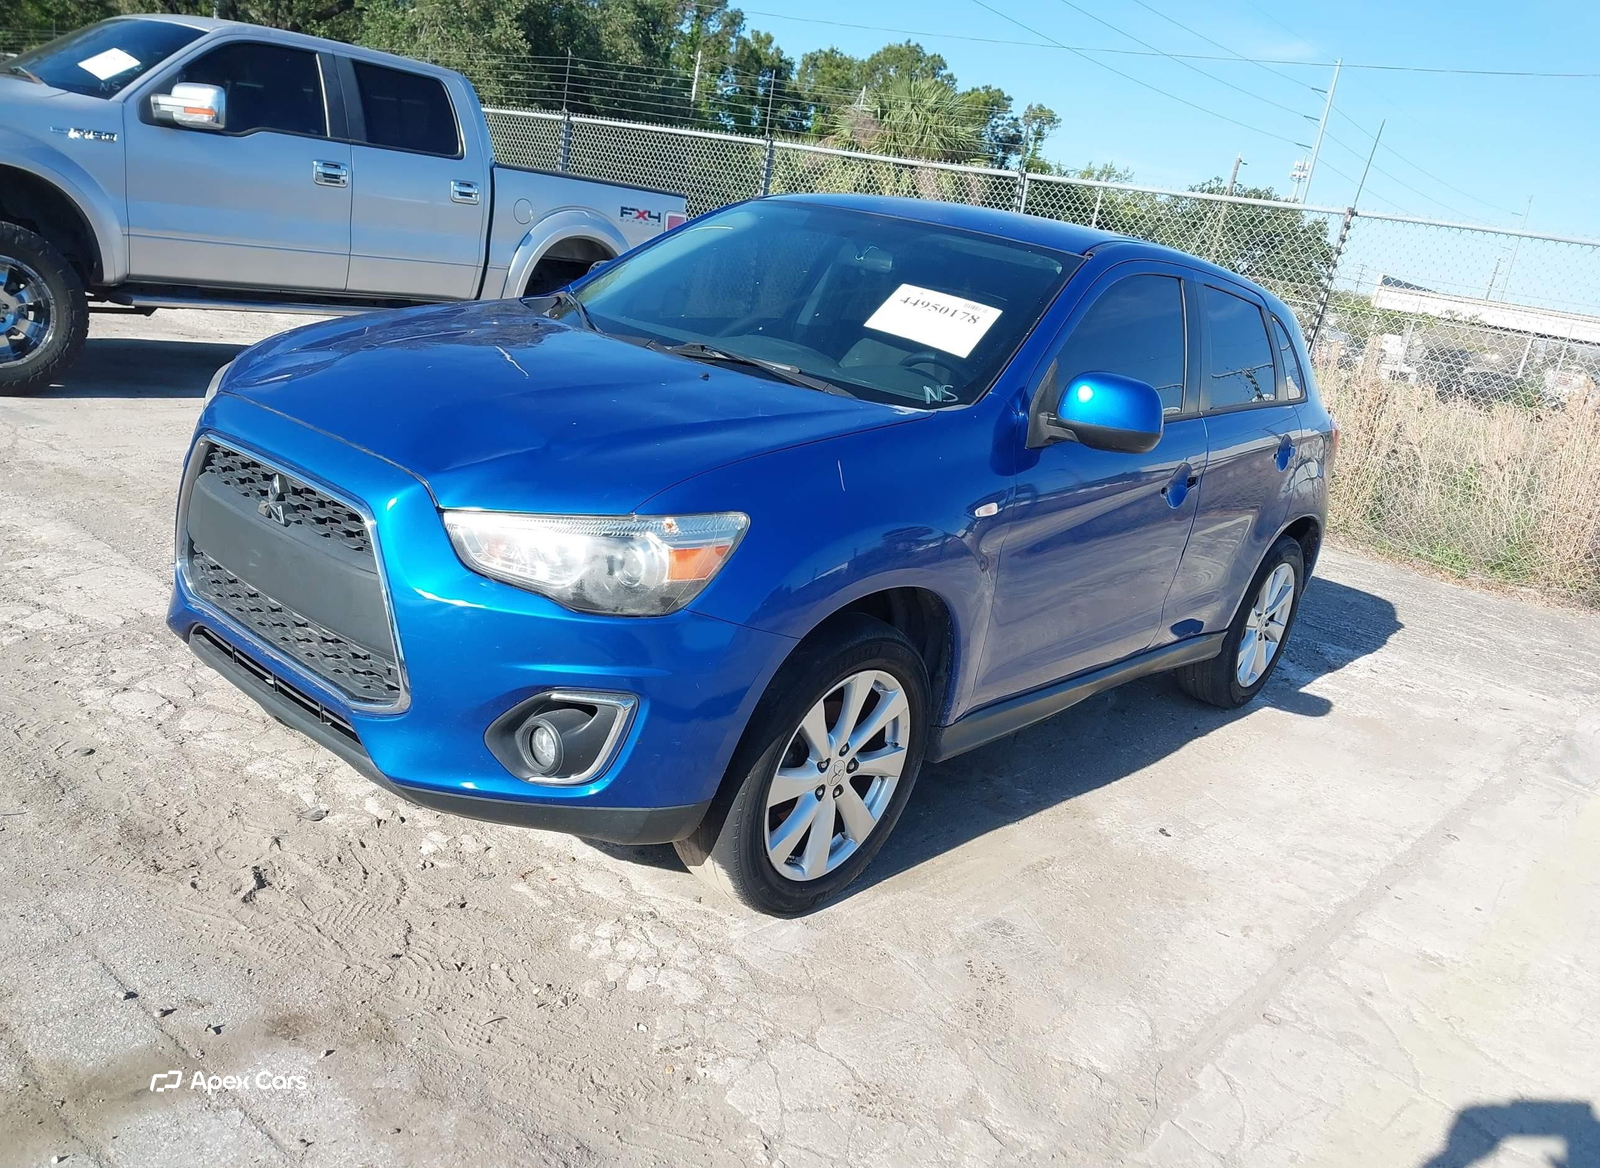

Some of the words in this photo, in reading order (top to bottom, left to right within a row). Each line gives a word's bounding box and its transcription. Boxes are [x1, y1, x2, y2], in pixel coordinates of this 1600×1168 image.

[620, 206, 661, 223] FX4
[900, 296, 980, 325] 44950178
[923, 384, 959, 405] NS
